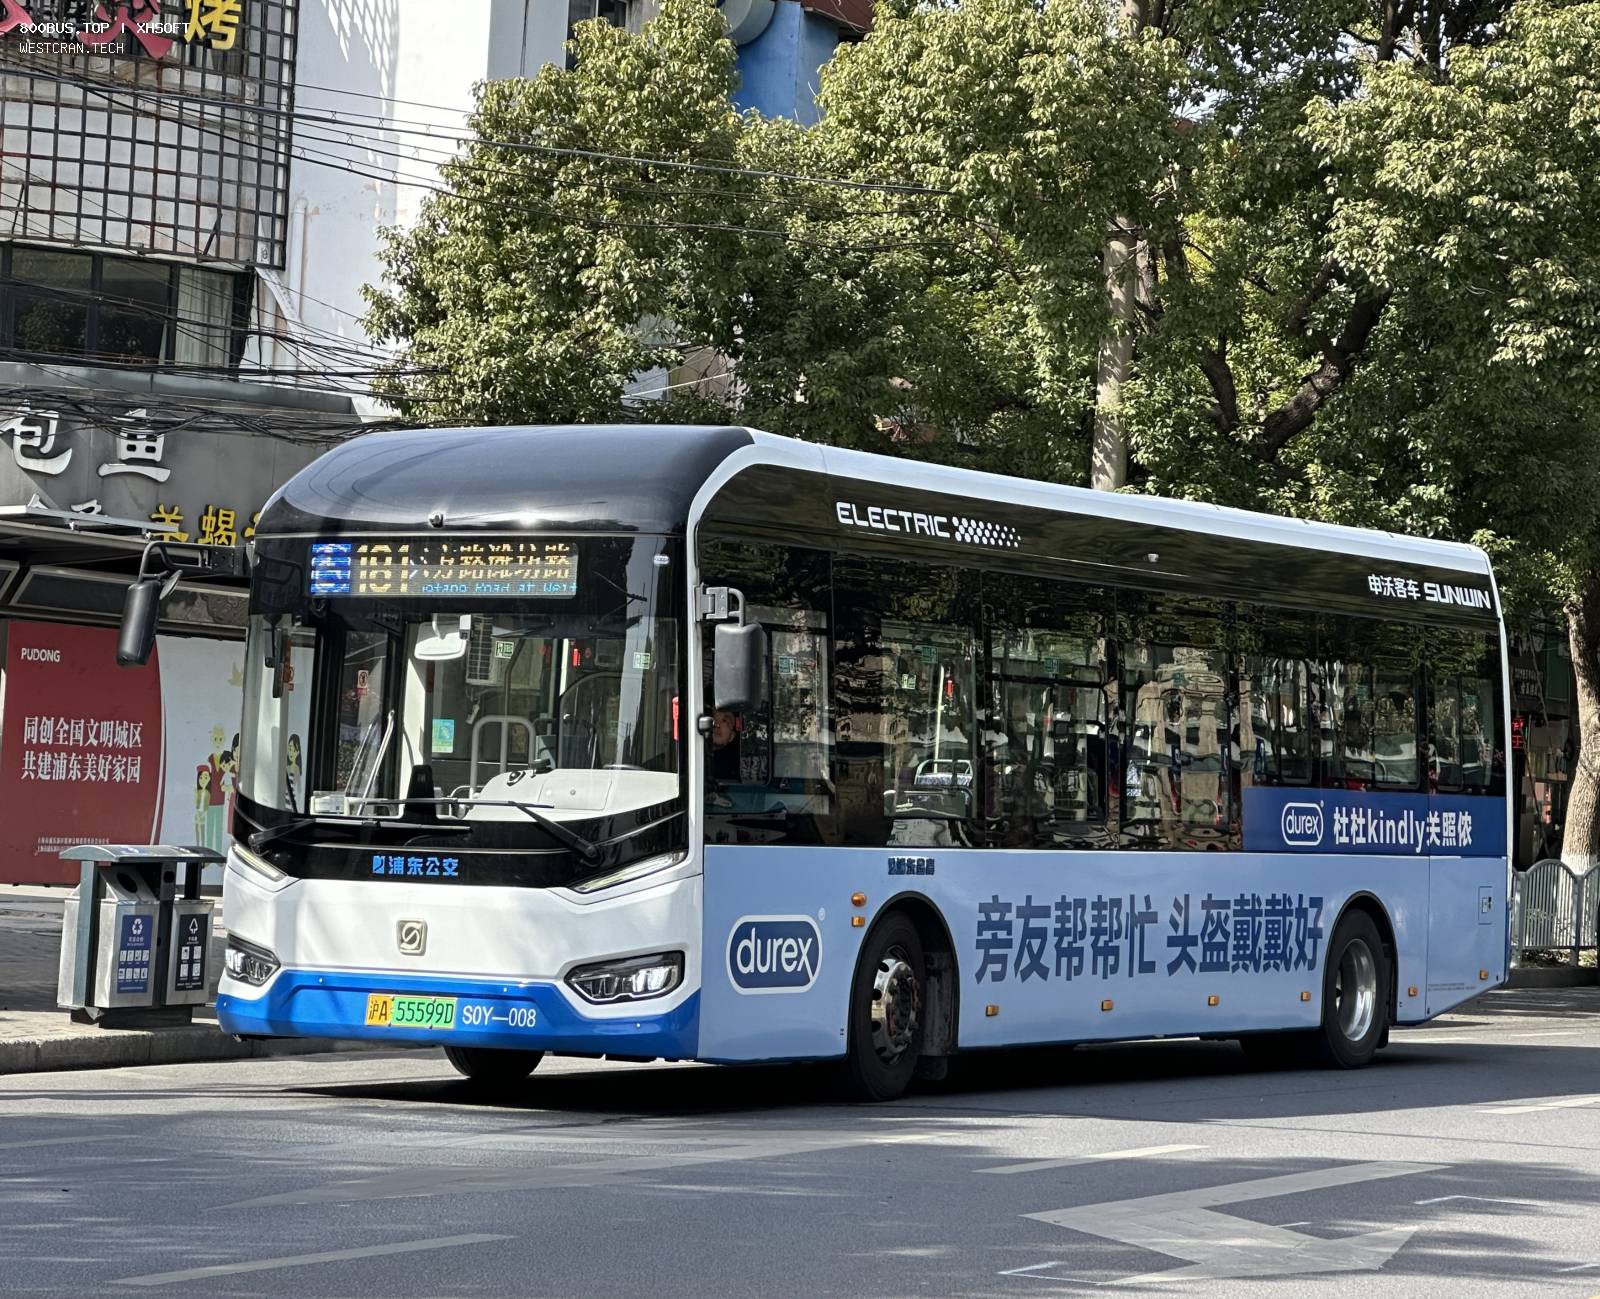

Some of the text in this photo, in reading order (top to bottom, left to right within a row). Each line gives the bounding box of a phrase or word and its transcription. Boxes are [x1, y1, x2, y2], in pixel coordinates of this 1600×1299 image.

[150, 504, 260, 546] 羊蝎
[836, 501, 951, 538] ELECTRIC
[357, 544, 410, 593] 101
[1367, 573, 1421, 600] 申沃客车
[1423, 582, 1492, 609] SUNWIN
[21, 648, 61, 663] PUDONG
[24, 716, 144, 748] 同创全国文明城区
[21, 750, 141, 784] 共建浦东美好家园
[1286, 809, 1321, 840] durex
[388, 855, 459, 876] 浦东公交
[736, 927, 814, 981] durex
[974, 893, 1324, 985] 旁友帮帮忙 头盔戴戴好
